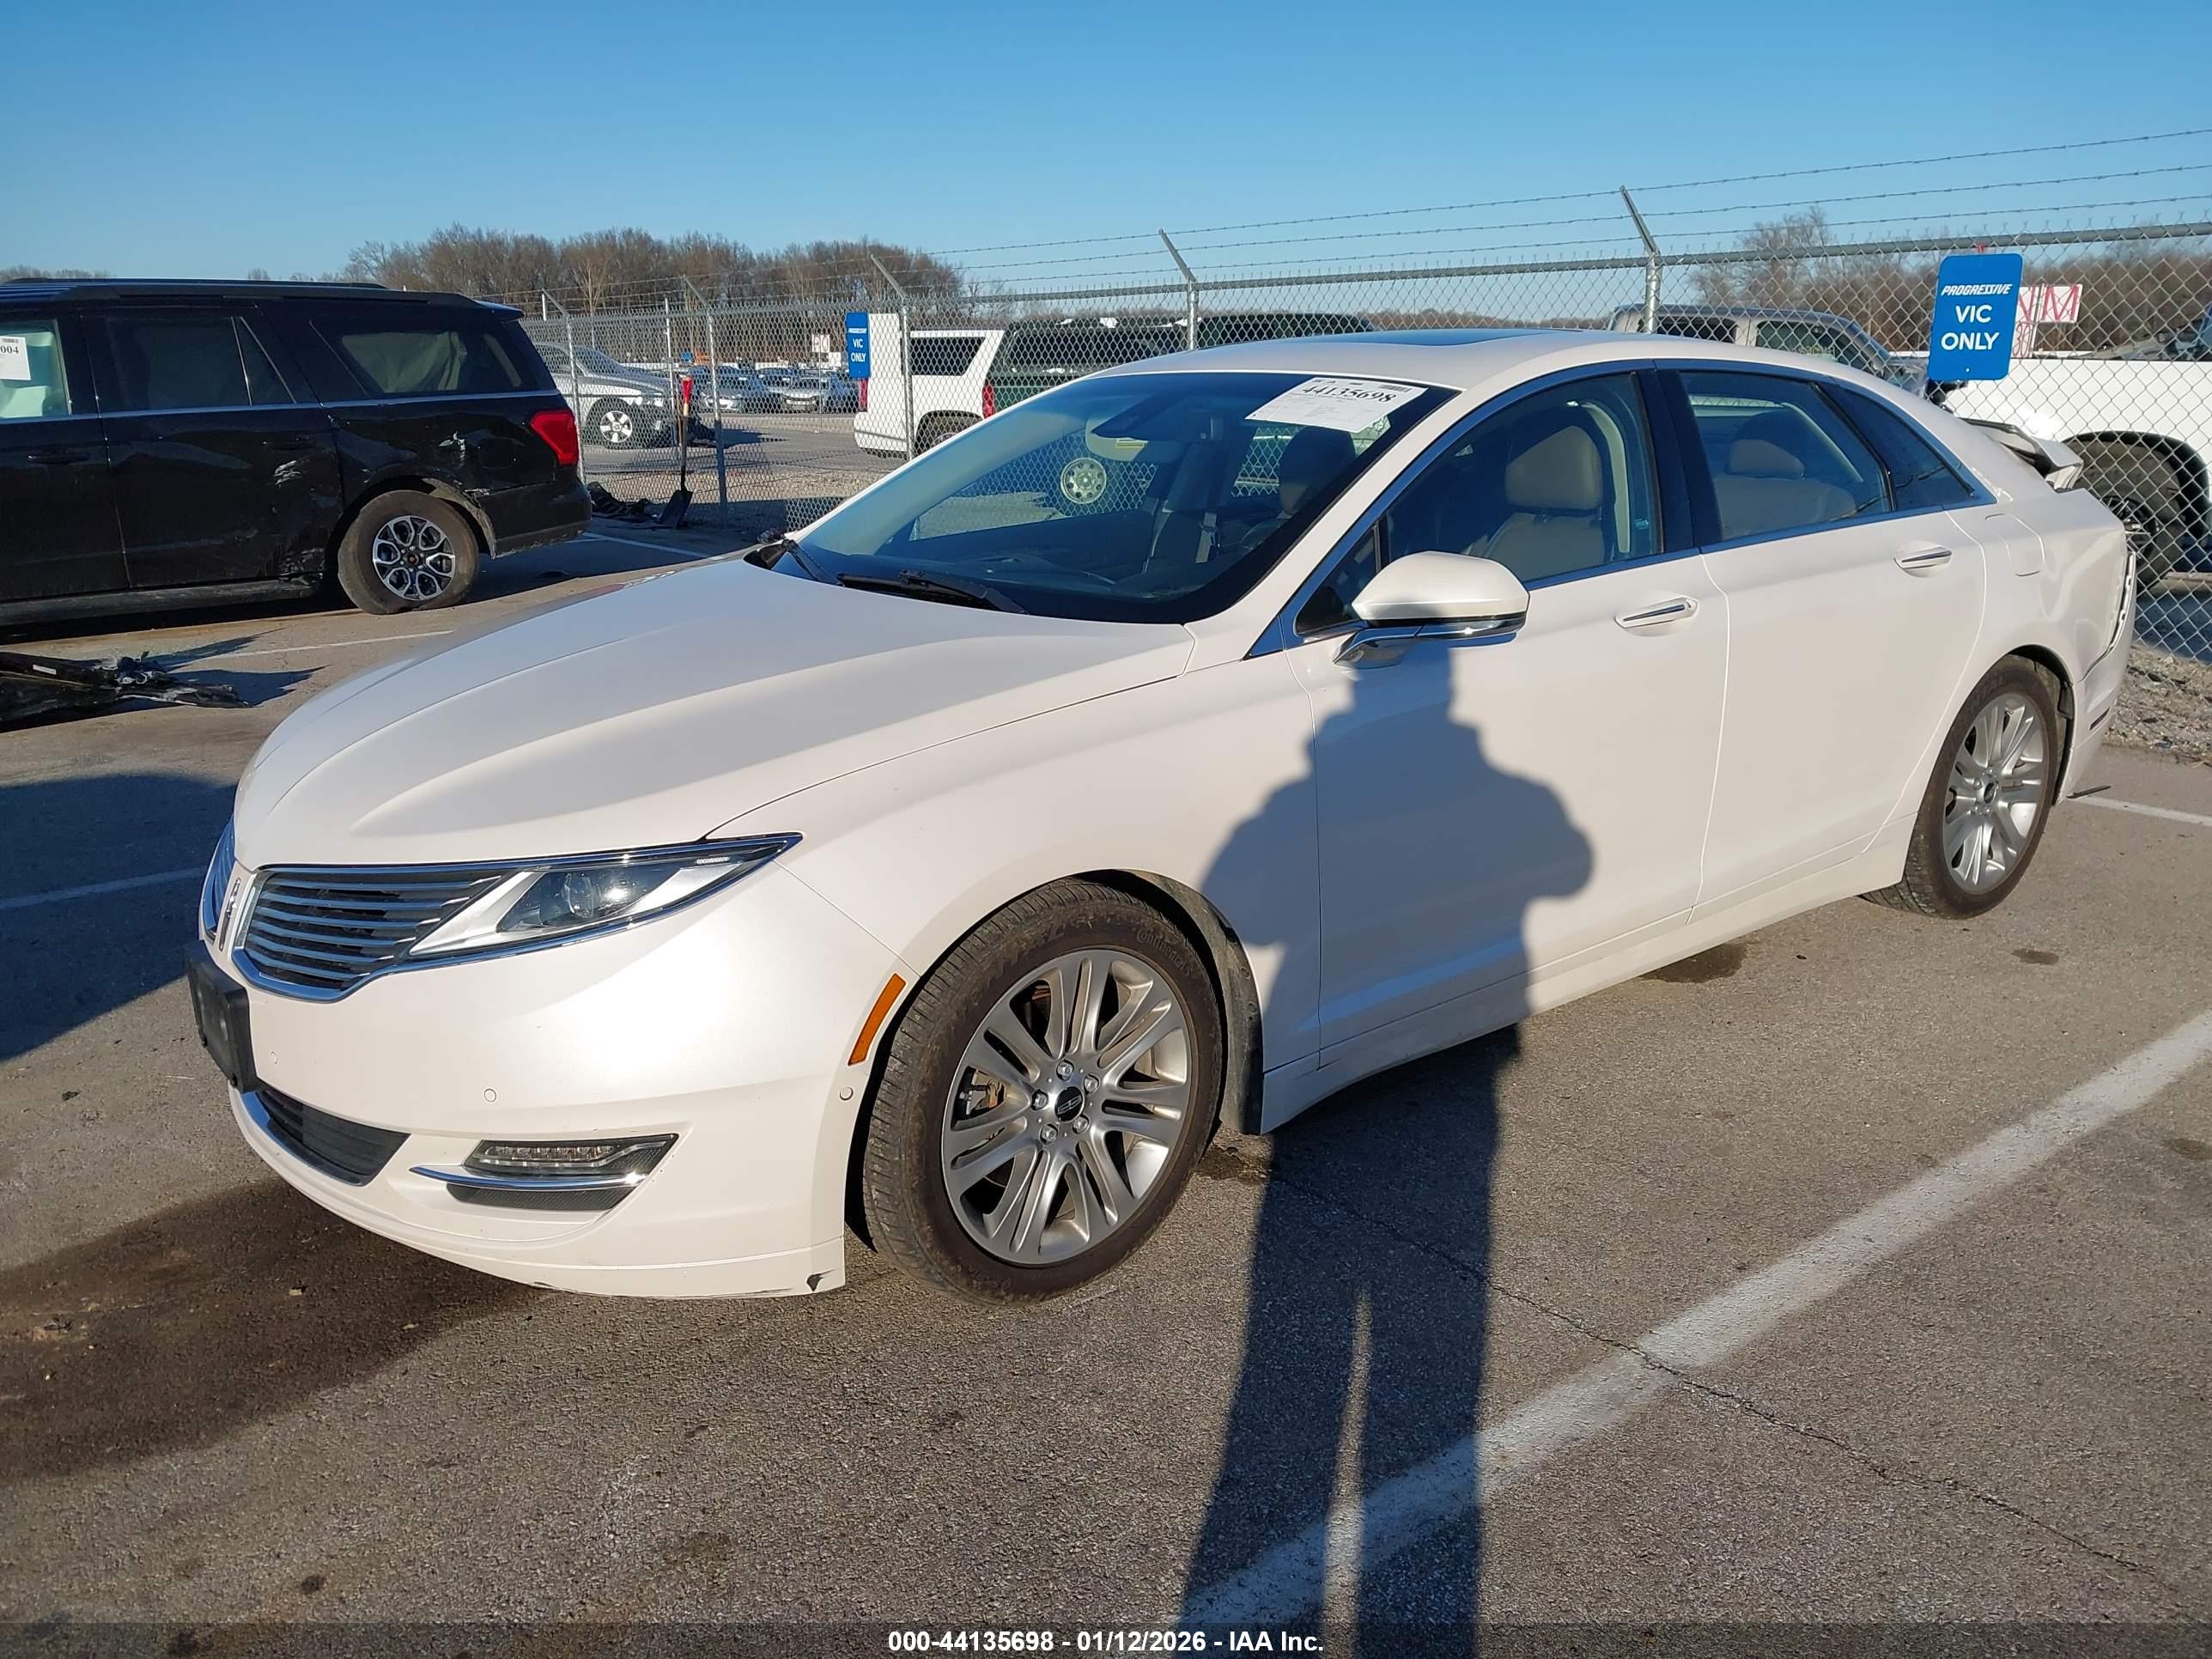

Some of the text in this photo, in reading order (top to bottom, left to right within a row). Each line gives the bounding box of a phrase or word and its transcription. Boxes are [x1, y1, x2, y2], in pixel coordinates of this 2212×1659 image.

[1941, 283, 2013, 296] PROGRESSIVE
[1954, 304, 1993, 324] VIC
[852, 338, 864, 349] VIC
[1940, 331, 2000, 350] ONLY
[850, 352, 866, 362] ONLY
[1301, 386, 1397, 403] 44135698
